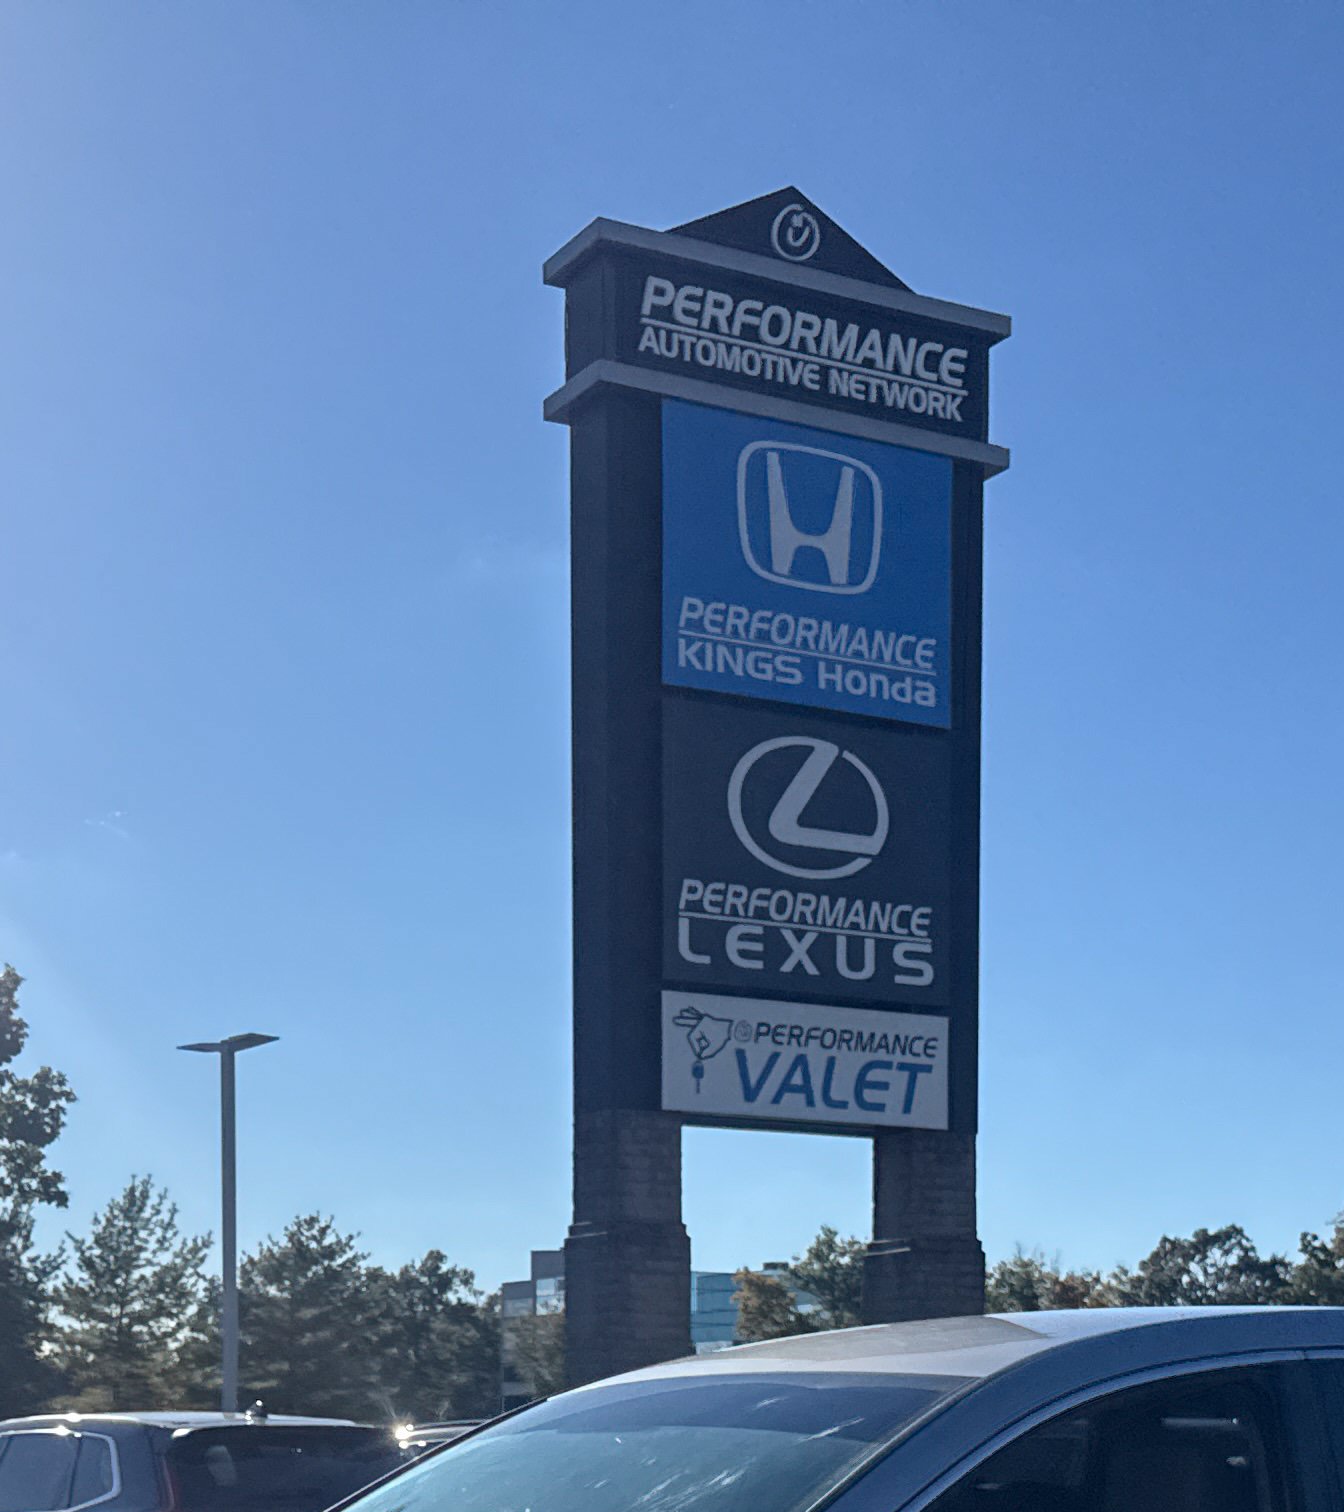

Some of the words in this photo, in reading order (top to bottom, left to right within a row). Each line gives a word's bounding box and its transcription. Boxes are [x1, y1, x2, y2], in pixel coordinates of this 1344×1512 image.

[640, 275, 969, 388] PERFORMANCE
[638, 327, 821, 392] AUTOMOTIVE
[828, 368, 964, 423] NETWORK
[678, 597, 937, 670] PERFORMANCE
[677, 638, 804, 686] KINGS
[817, 661, 937, 708] Honda
[678, 878, 933, 938] PERFORMANCE
[678, 917, 935, 987] LEXUS
[754, 1021, 938, 1060] PERFORMANCE
[734, 1048, 934, 1116] VALET
